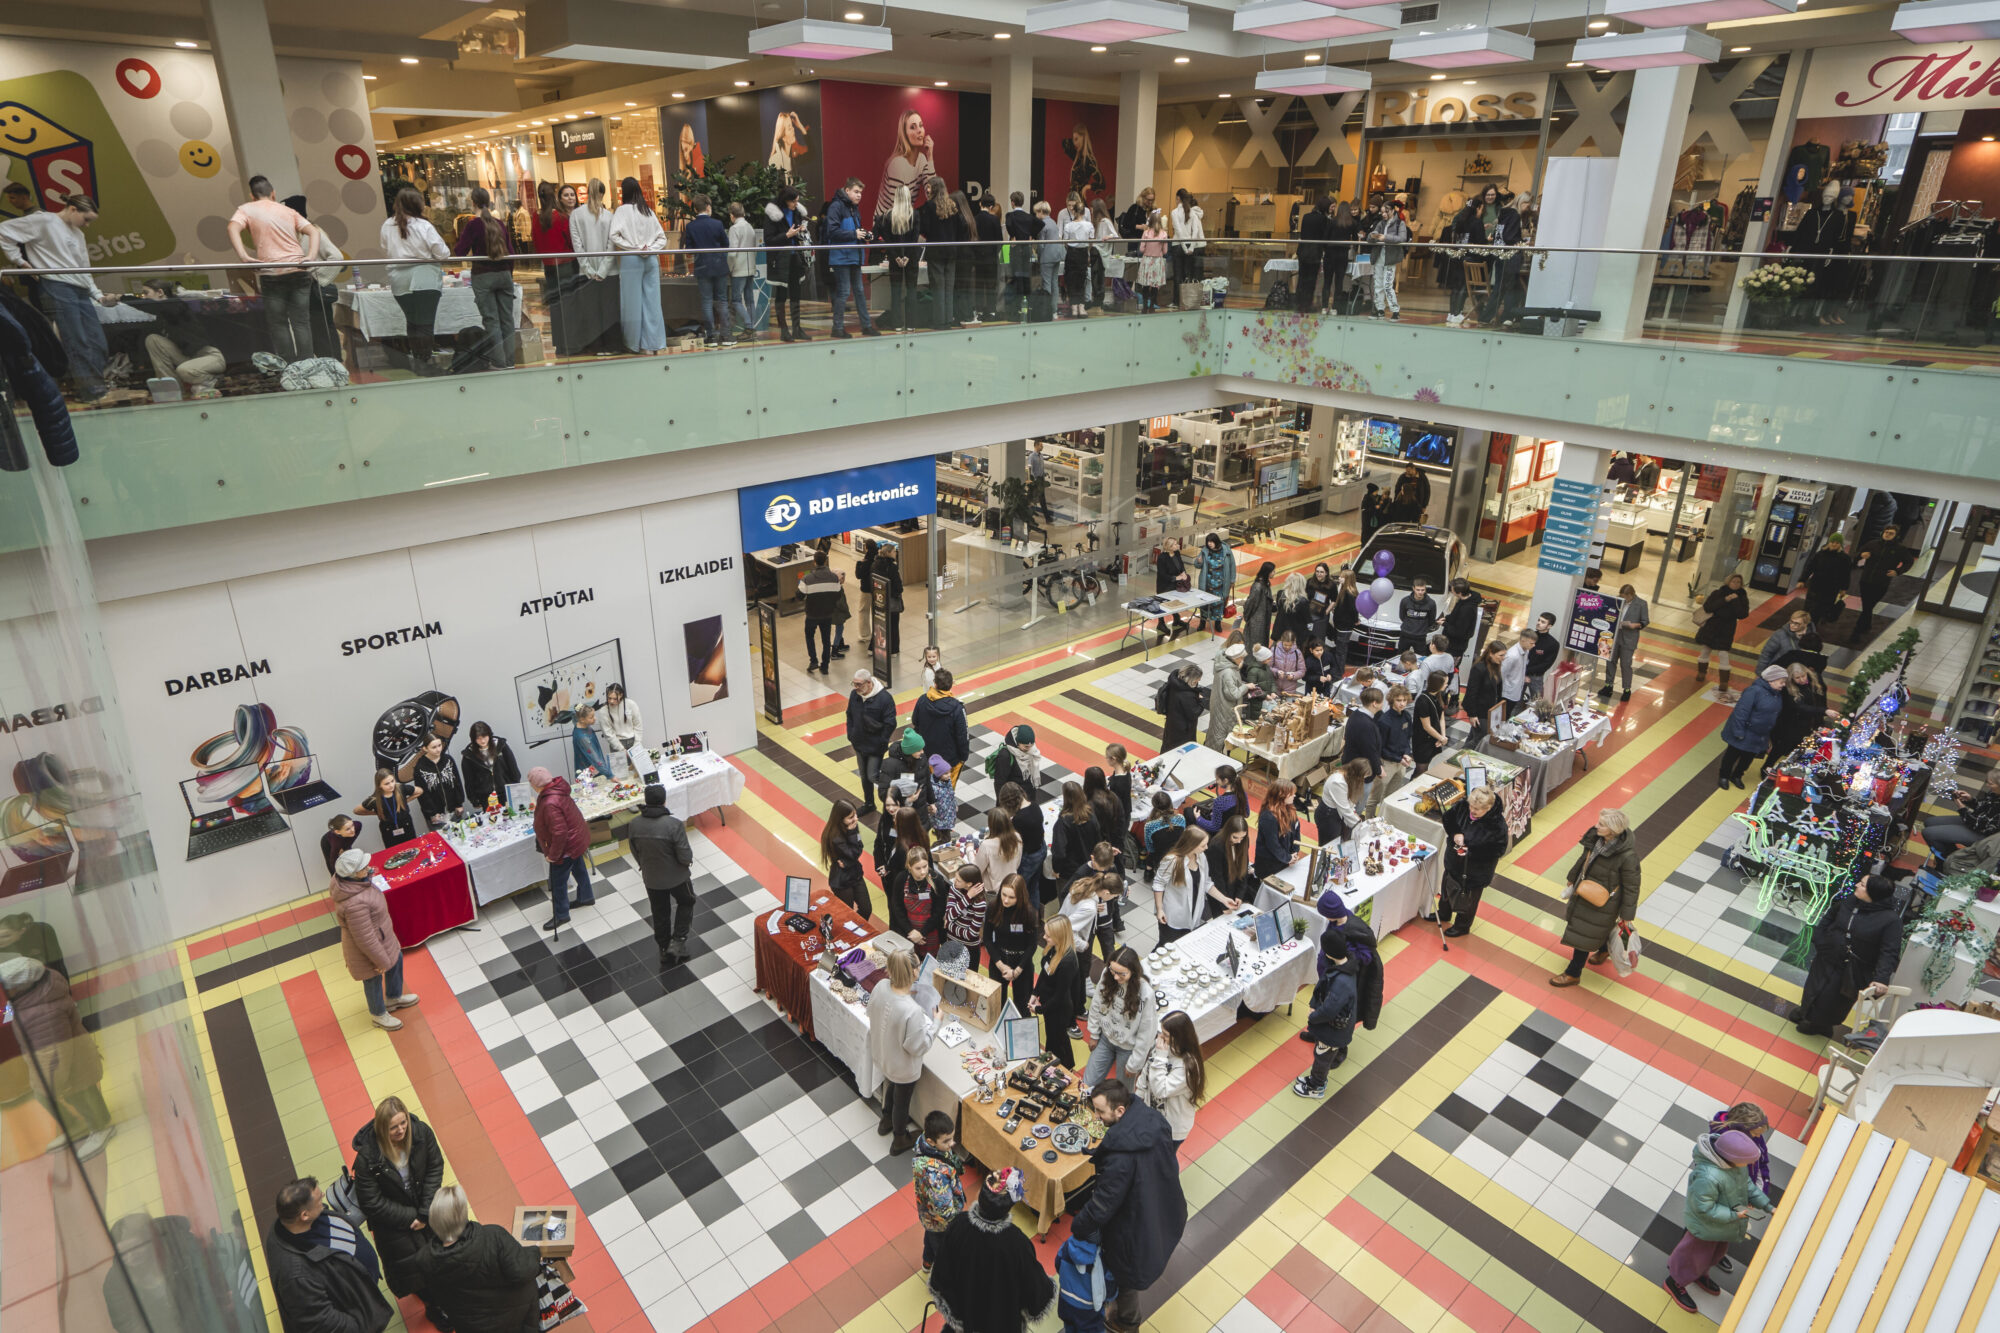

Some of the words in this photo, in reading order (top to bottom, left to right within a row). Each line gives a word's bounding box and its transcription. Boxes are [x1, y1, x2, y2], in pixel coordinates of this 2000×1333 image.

[1372, 88, 1538, 127] Rioss
[88, 231, 146, 261] etas
[809, 497, 834, 516] RD
[836, 482, 919, 510] Electronics
[1791, 490, 1812, 498] IZCILA
[659, 556, 733, 585] IZKLAIDEI
[519, 588, 594, 617] ATPŪTAI
[341, 621, 443, 656] SPORTAM
[164, 659, 272, 697] DARBAM
